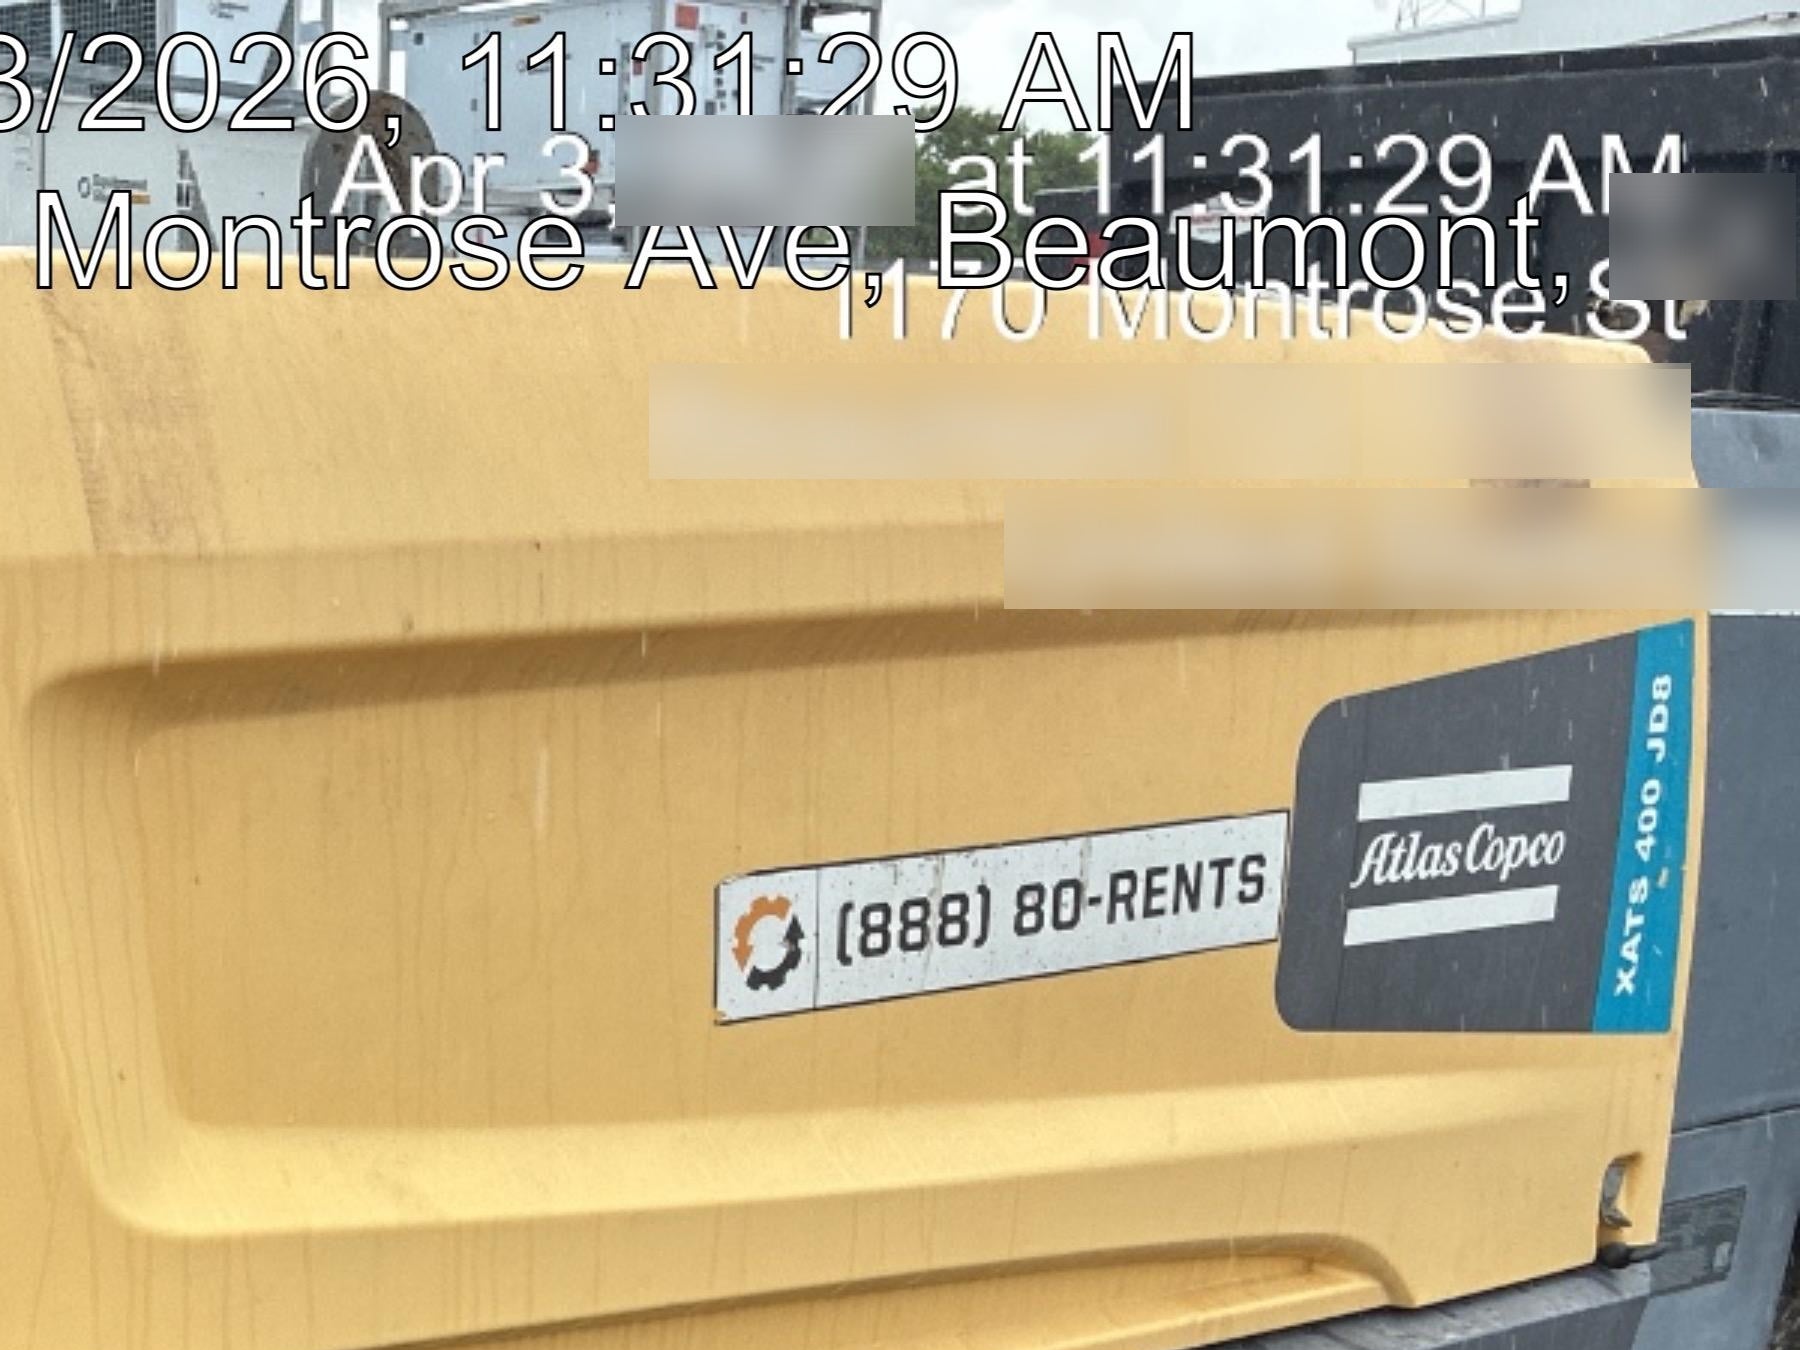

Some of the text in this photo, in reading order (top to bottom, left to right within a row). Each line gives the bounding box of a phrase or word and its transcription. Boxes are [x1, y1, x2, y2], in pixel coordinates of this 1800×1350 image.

[1350, 821, 1566, 889] Atlas Copco
[1614, 673, 1673, 996] XATS 400 JD8
[836, 853, 1267, 966] (888) 80-RENTS
